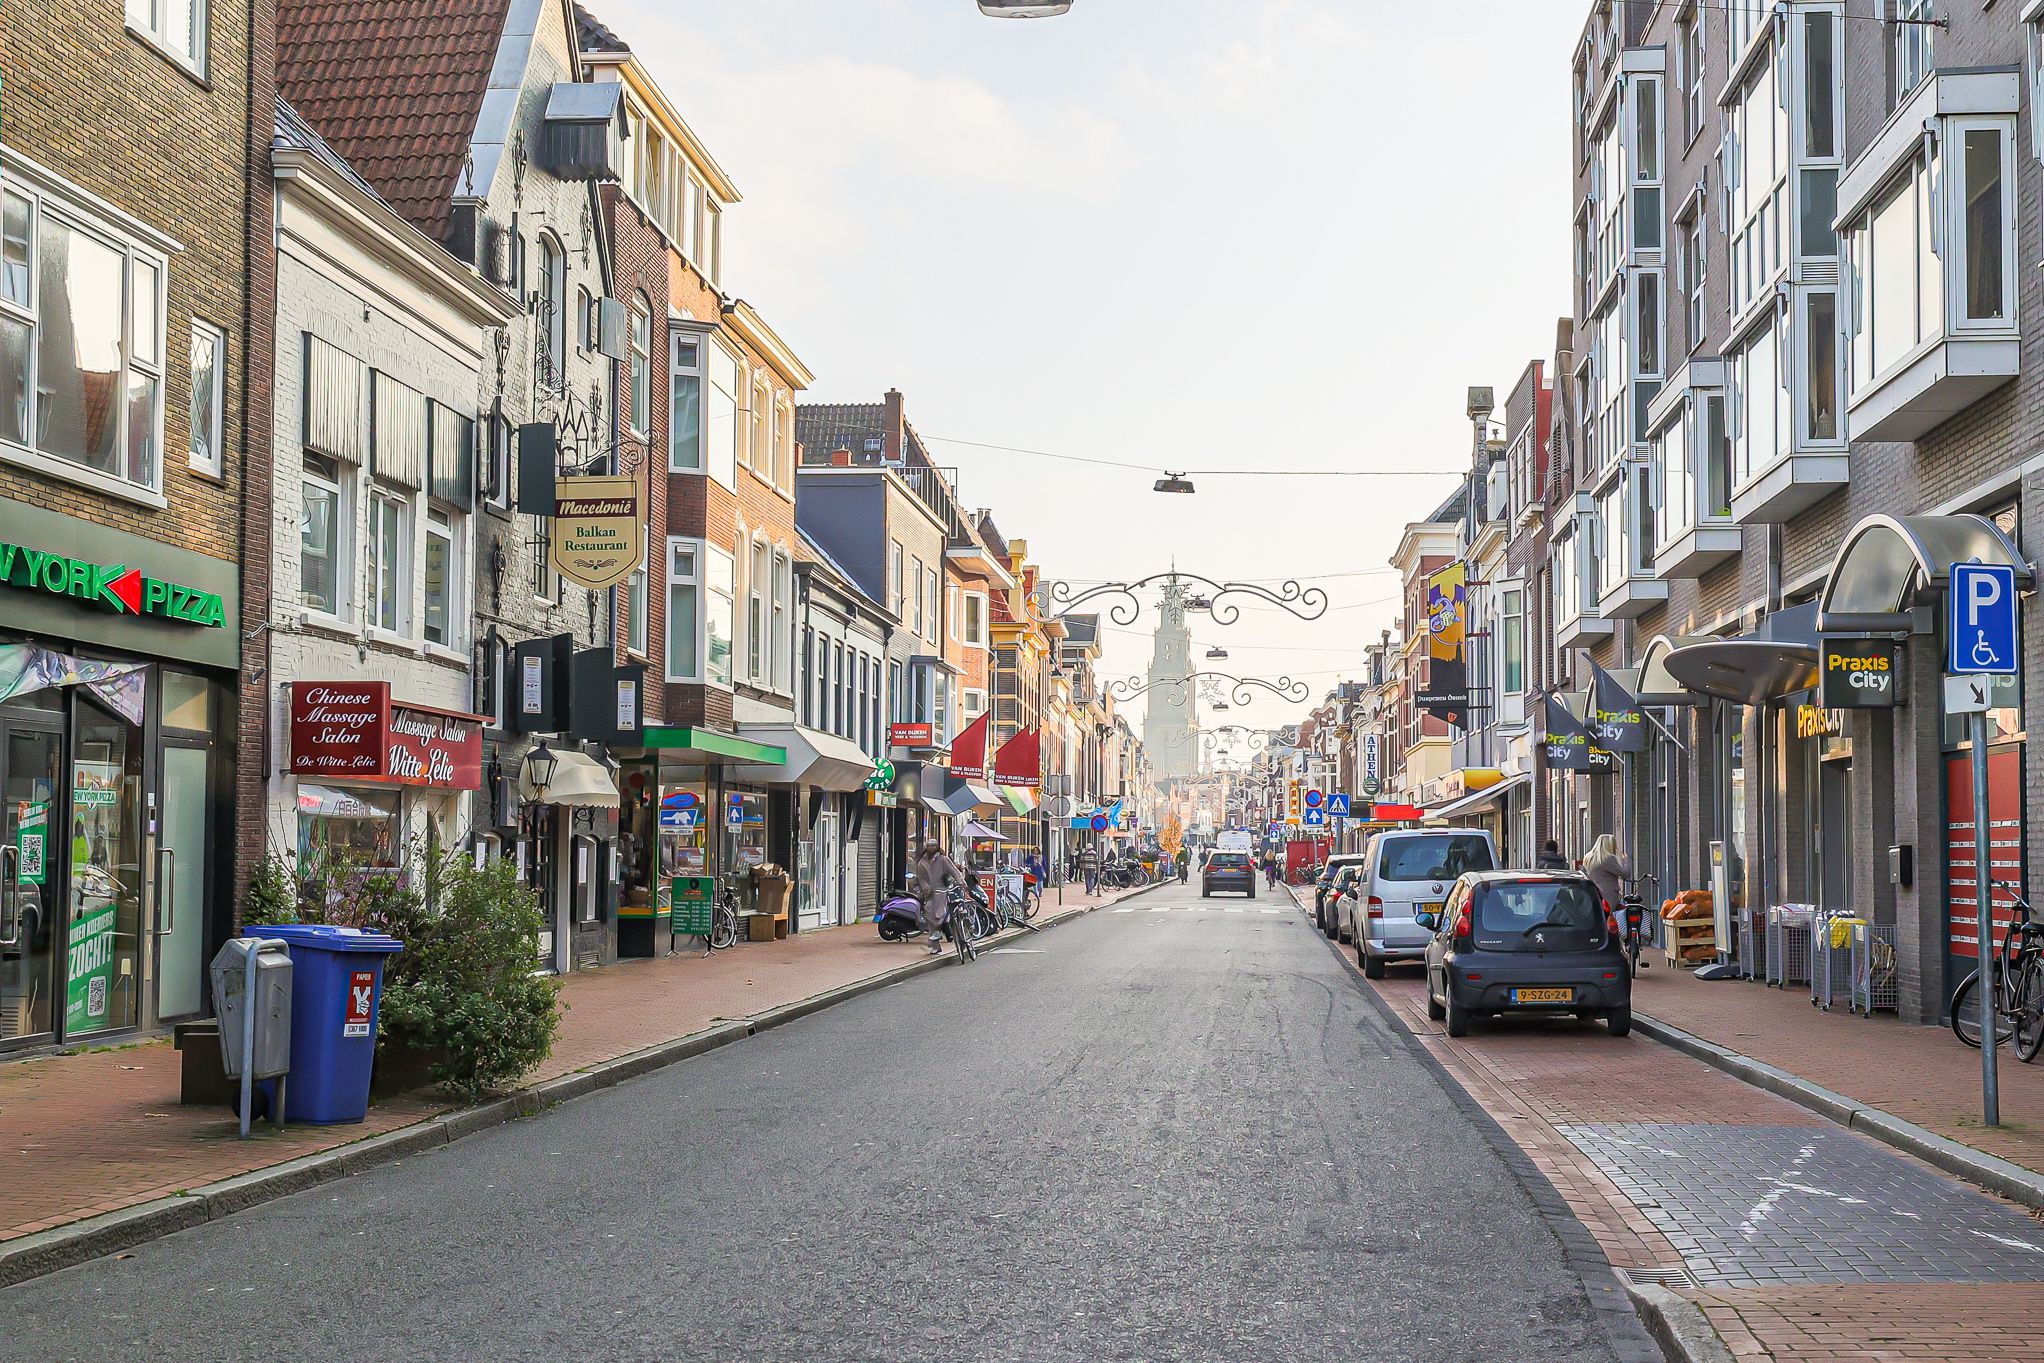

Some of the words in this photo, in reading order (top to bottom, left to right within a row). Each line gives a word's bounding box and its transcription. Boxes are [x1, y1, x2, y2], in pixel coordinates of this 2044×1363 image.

[559, 500, 632, 515] Macedonië
[576, 525, 616, 538] Balkan
[565, 540, 628, 552] Restaurant
[21, 547, 125, 614] YORK
[145, 578, 227, 629] PIZZA
[1968, 572, 2001, 626] P
[1828, 653, 1889, 672] Praxis
[1849, 671, 1890, 692] City
[305, 687, 371, 705] Chinese
[297, 707, 377, 728] Massage
[1597, 709, 1641, 724] Praxis
[1797, 703, 1826, 739] Praxis
[312, 727, 361, 744] Salon
[390, 709, 437, 747] Massage
[439, 717, 466, 744] Salon
[1597, 723, 1624, 741] City
[1546, 733, 1585, 745] Praxis
[1547, 745, 1571, 760] City
[1588, 753, 1610, 766] City
[296, 755, 314, 767] De
[316, 755, 347, 767] Witte
[347, 755, 376, 769] Lelie
[389, 745, 422, 777] Witte
[424, 747, 455, 785] Lelie
[84, 791, 98, 801] YORK
[1520, 990, 1568, 1000] 9-SZG-24
